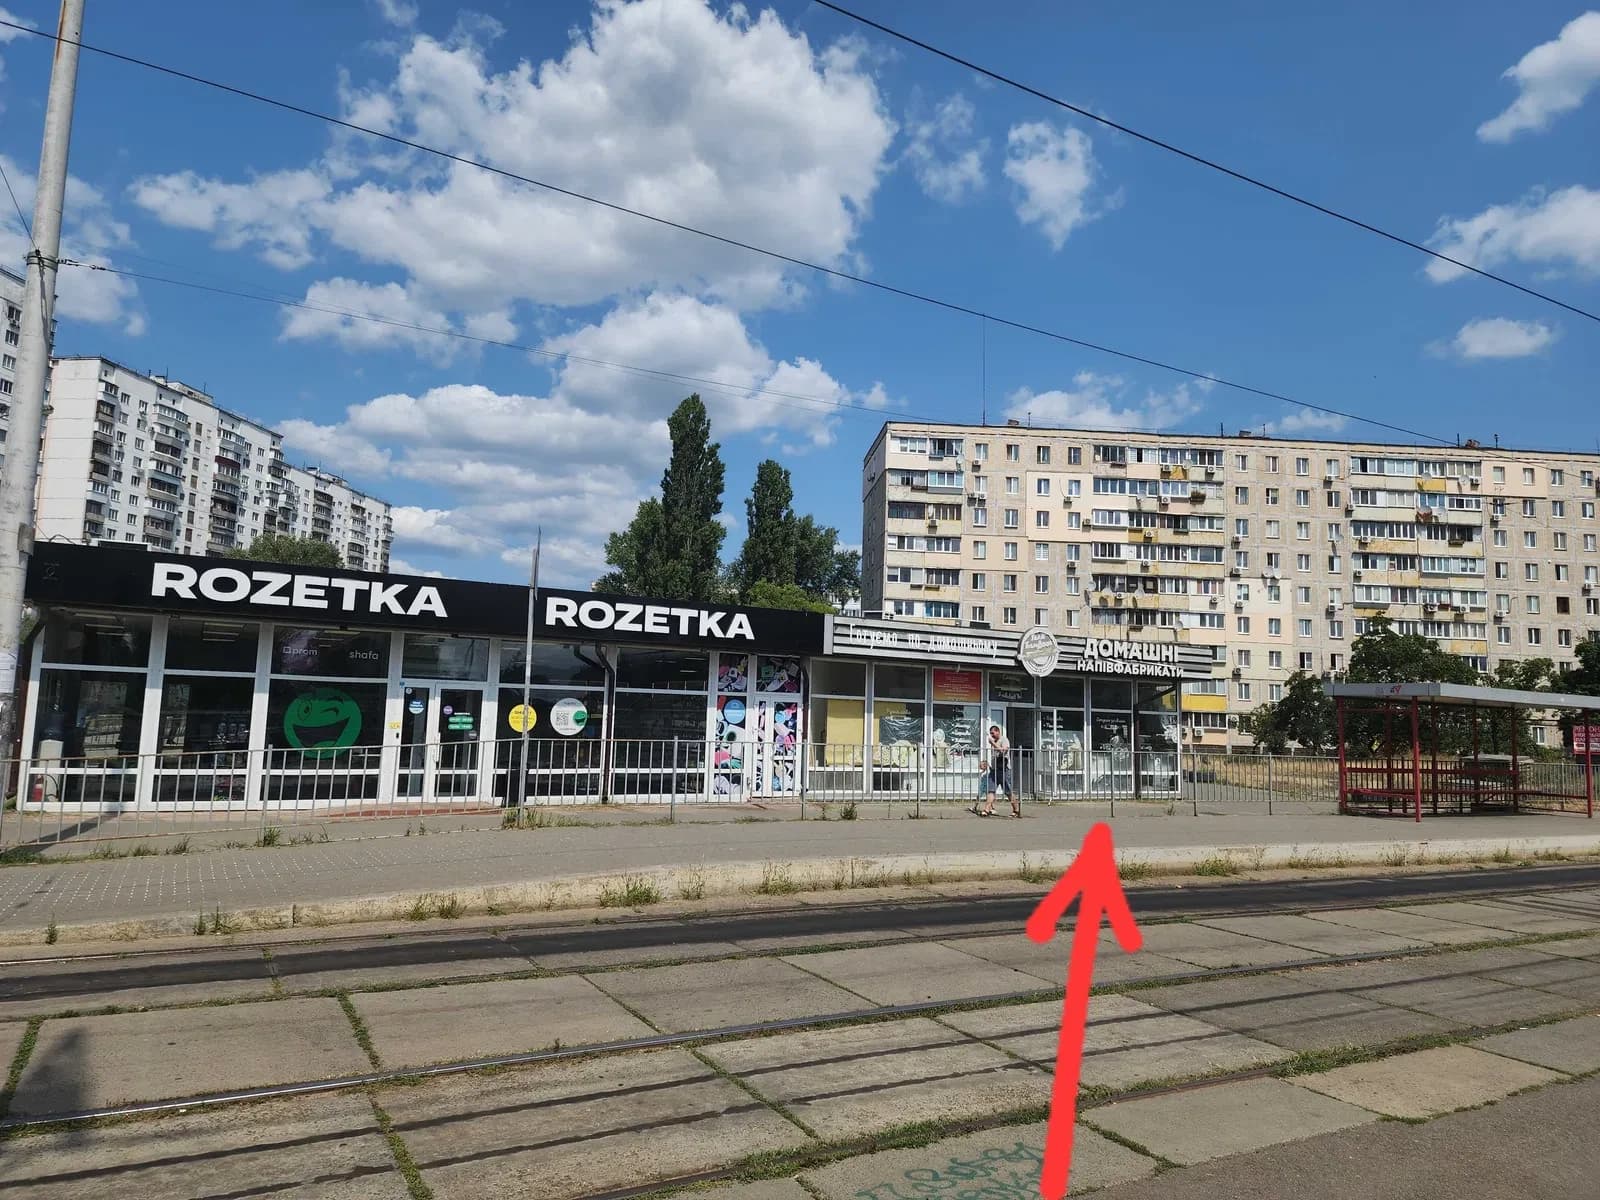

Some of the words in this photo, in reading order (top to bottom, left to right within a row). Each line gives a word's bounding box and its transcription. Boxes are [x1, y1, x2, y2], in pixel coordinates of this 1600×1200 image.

[151, 562, 448, 618] ROZETKA
[545, 596, 755, 641] ROZETKA
[292, 647, 318, 656] prom
[348, 650, 379, 660] shafa
[1083, 637, 1180, 663] ДОМАШНІ
[1076, 659, 1184, 678] НАПІВФАБРИКАТИ
